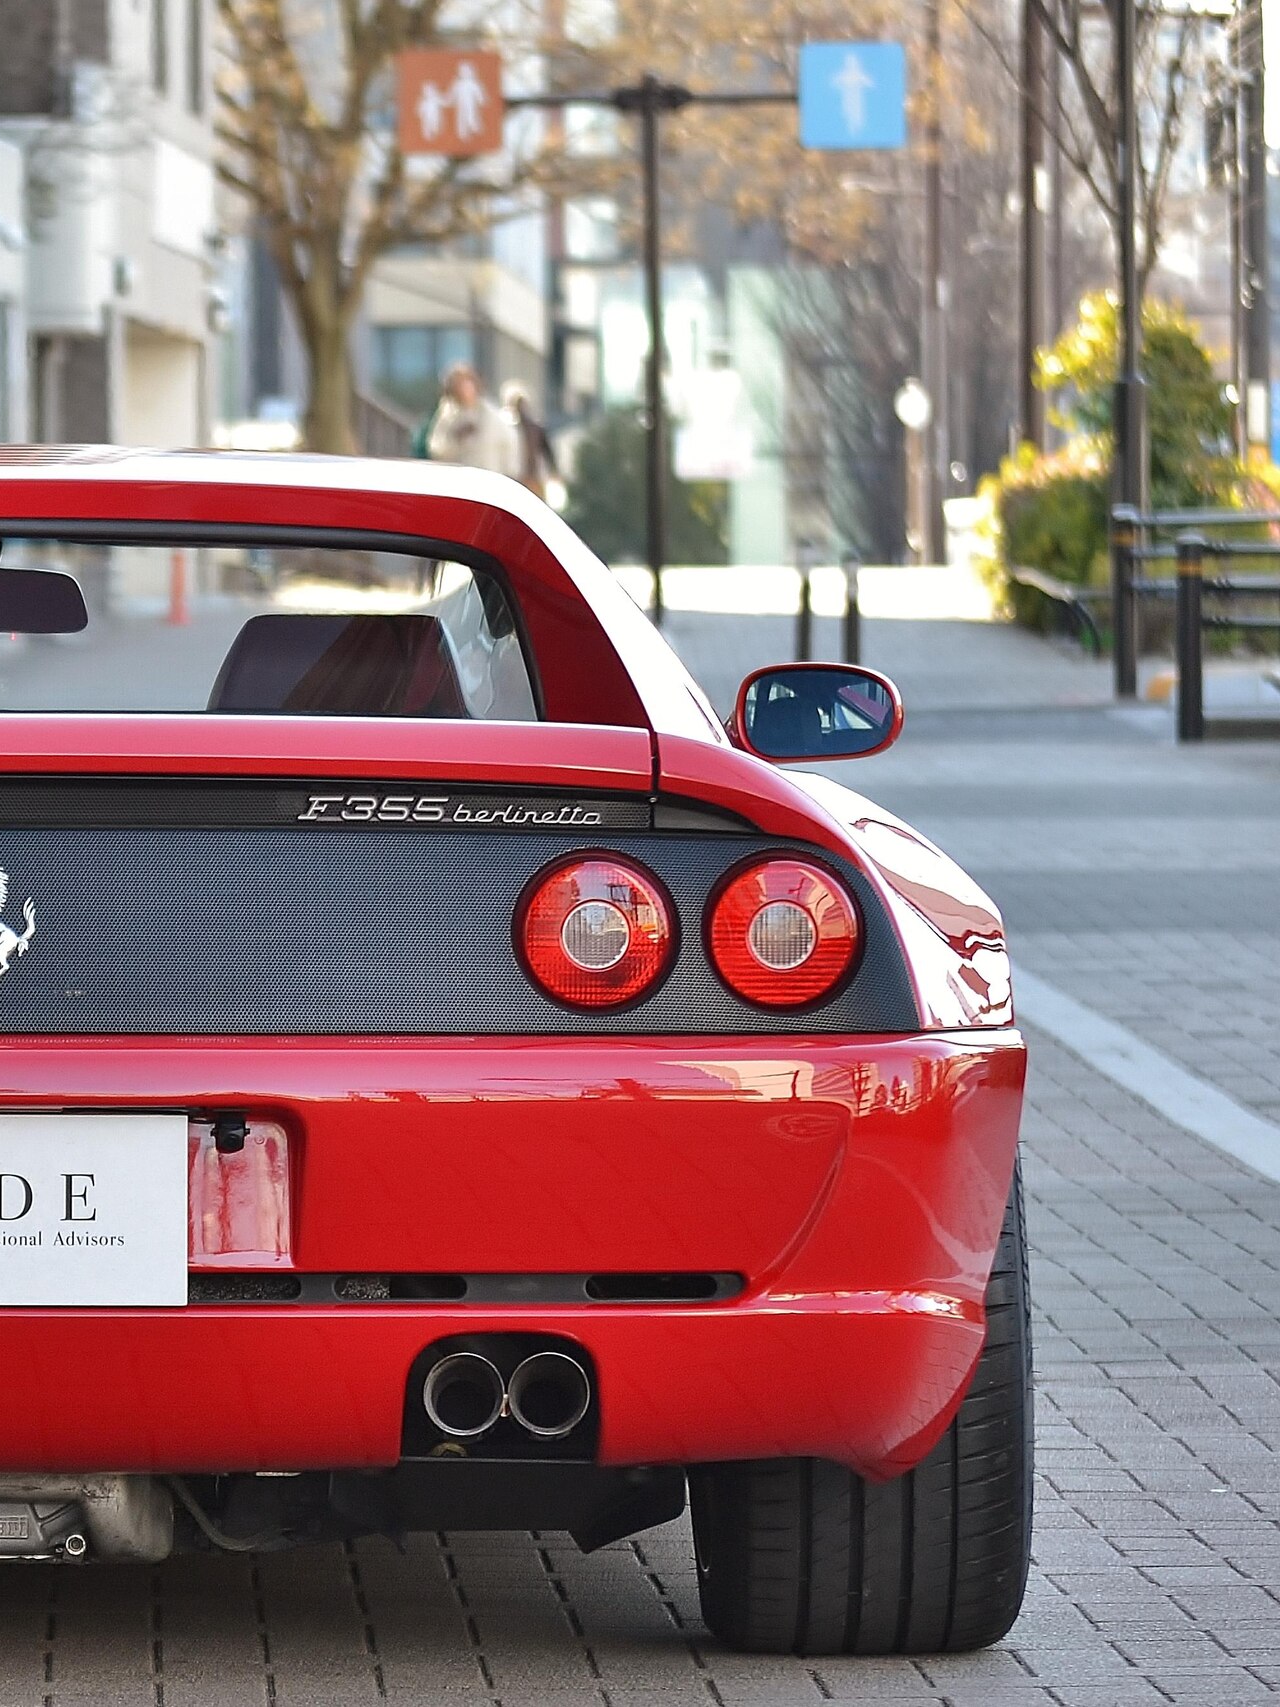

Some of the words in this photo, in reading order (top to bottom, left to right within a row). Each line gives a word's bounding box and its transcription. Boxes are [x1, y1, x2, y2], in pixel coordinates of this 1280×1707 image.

[298, 797, 449, 821] F355
[453, 804, 602, 825] berlinetta
[53, 1230, 125, 1247] Advisors
